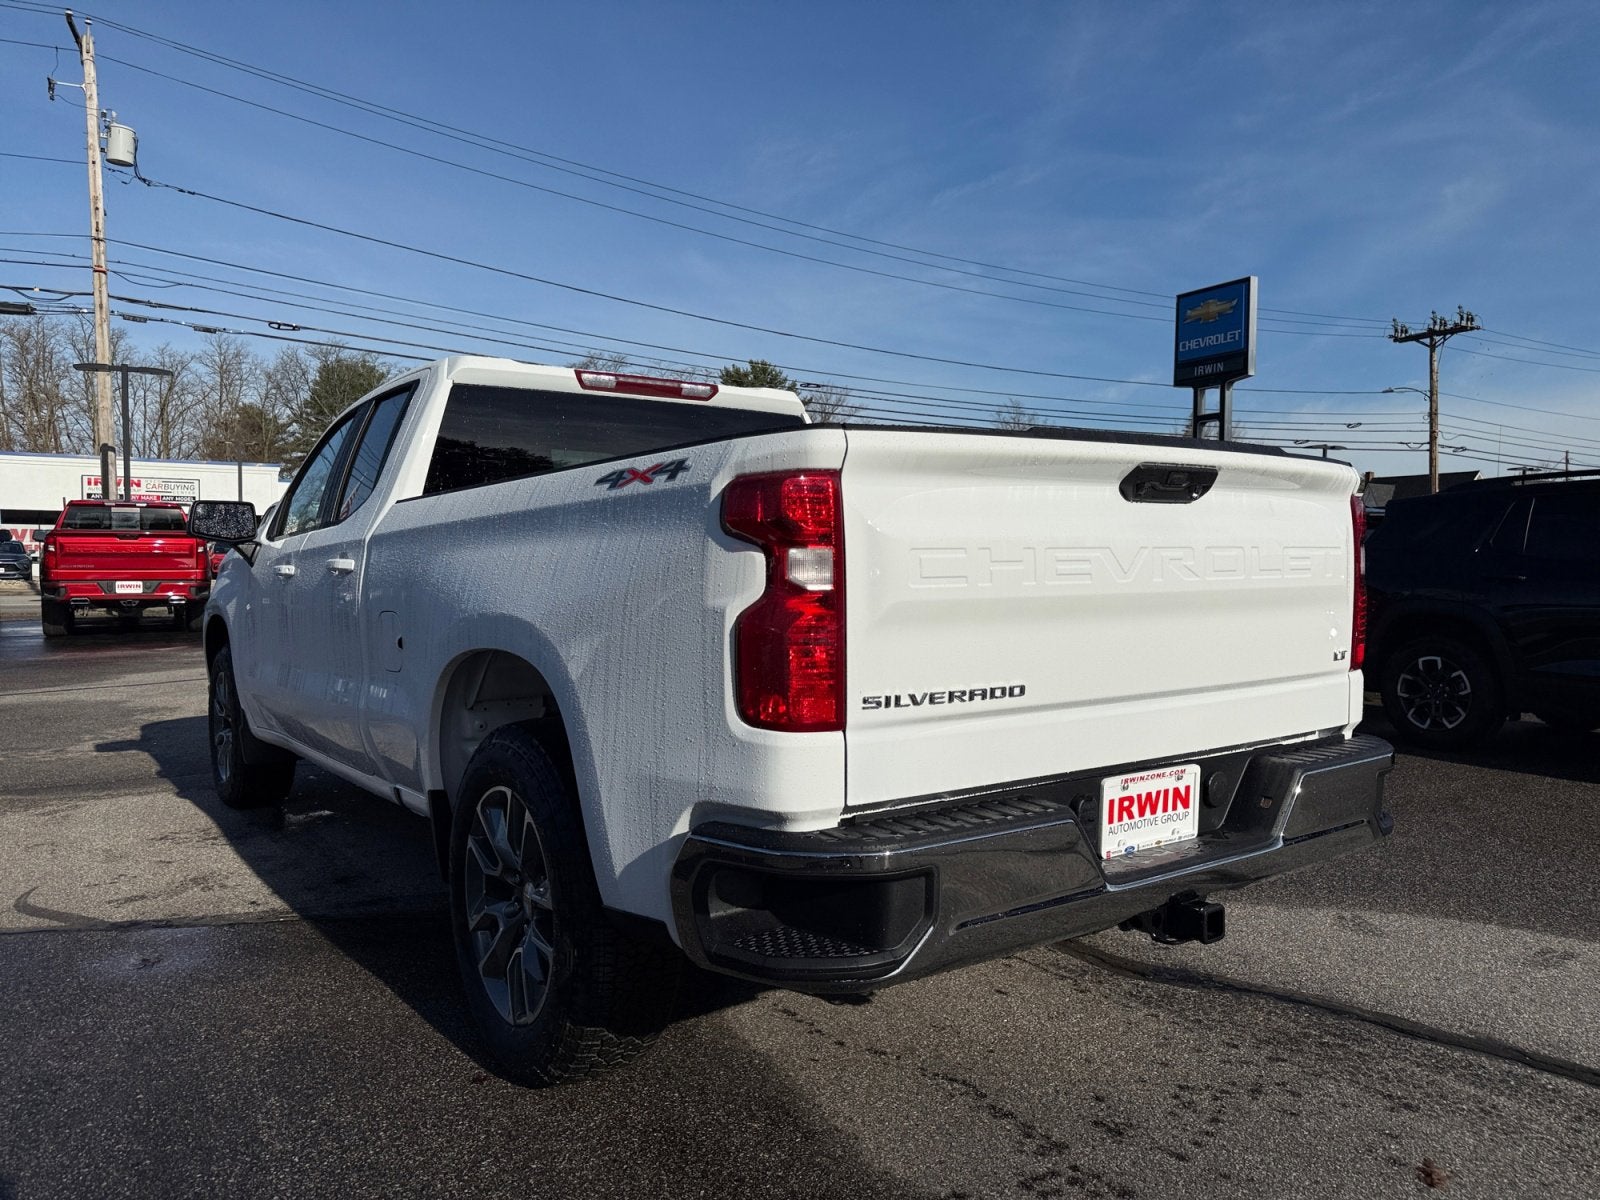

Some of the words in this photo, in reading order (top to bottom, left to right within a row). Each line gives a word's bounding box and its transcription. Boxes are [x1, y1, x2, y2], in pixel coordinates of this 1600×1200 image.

[1180, 329, 1241, 351] CHEVROLET
[1194, 362, 1224, 376] IRWIN
[87, 477, 141, 488] IRN
[908, 545, 1342, 589] CHEVROLET
[1333, 650, 1348, 661] LT
[861, 685, 1026, 710] SILVERADO
[1121, 769, 1186, 785] IRWINZONE.COM
[1107, 785, 1191, 825] IRWIN
[1108, 817, 1159, 836] AUTOMOTIVE
[1160, 811, 1190, 824] GROUP
